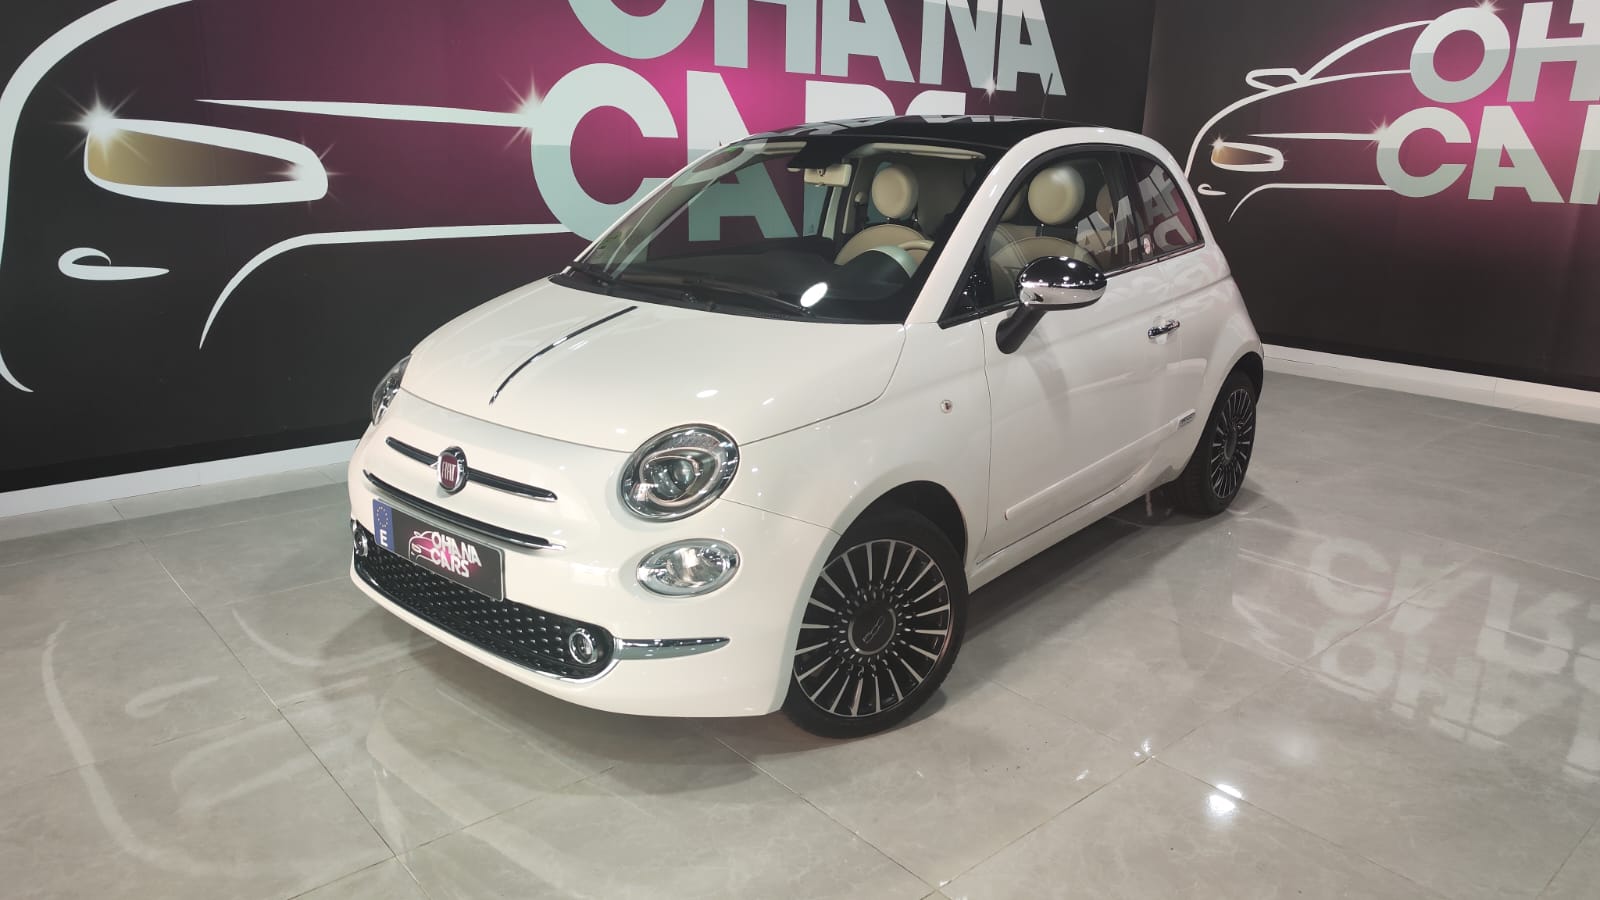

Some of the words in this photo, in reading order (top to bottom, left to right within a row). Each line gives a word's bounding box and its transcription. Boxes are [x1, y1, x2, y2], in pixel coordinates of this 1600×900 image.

[531, 63, 967, 246] CA
[441, 461, 456, 481] FIAT
[380, 530, 389, 547] E
[431, 532, 482, 567] OHANA
[431, 548, 470, 577] CARS
